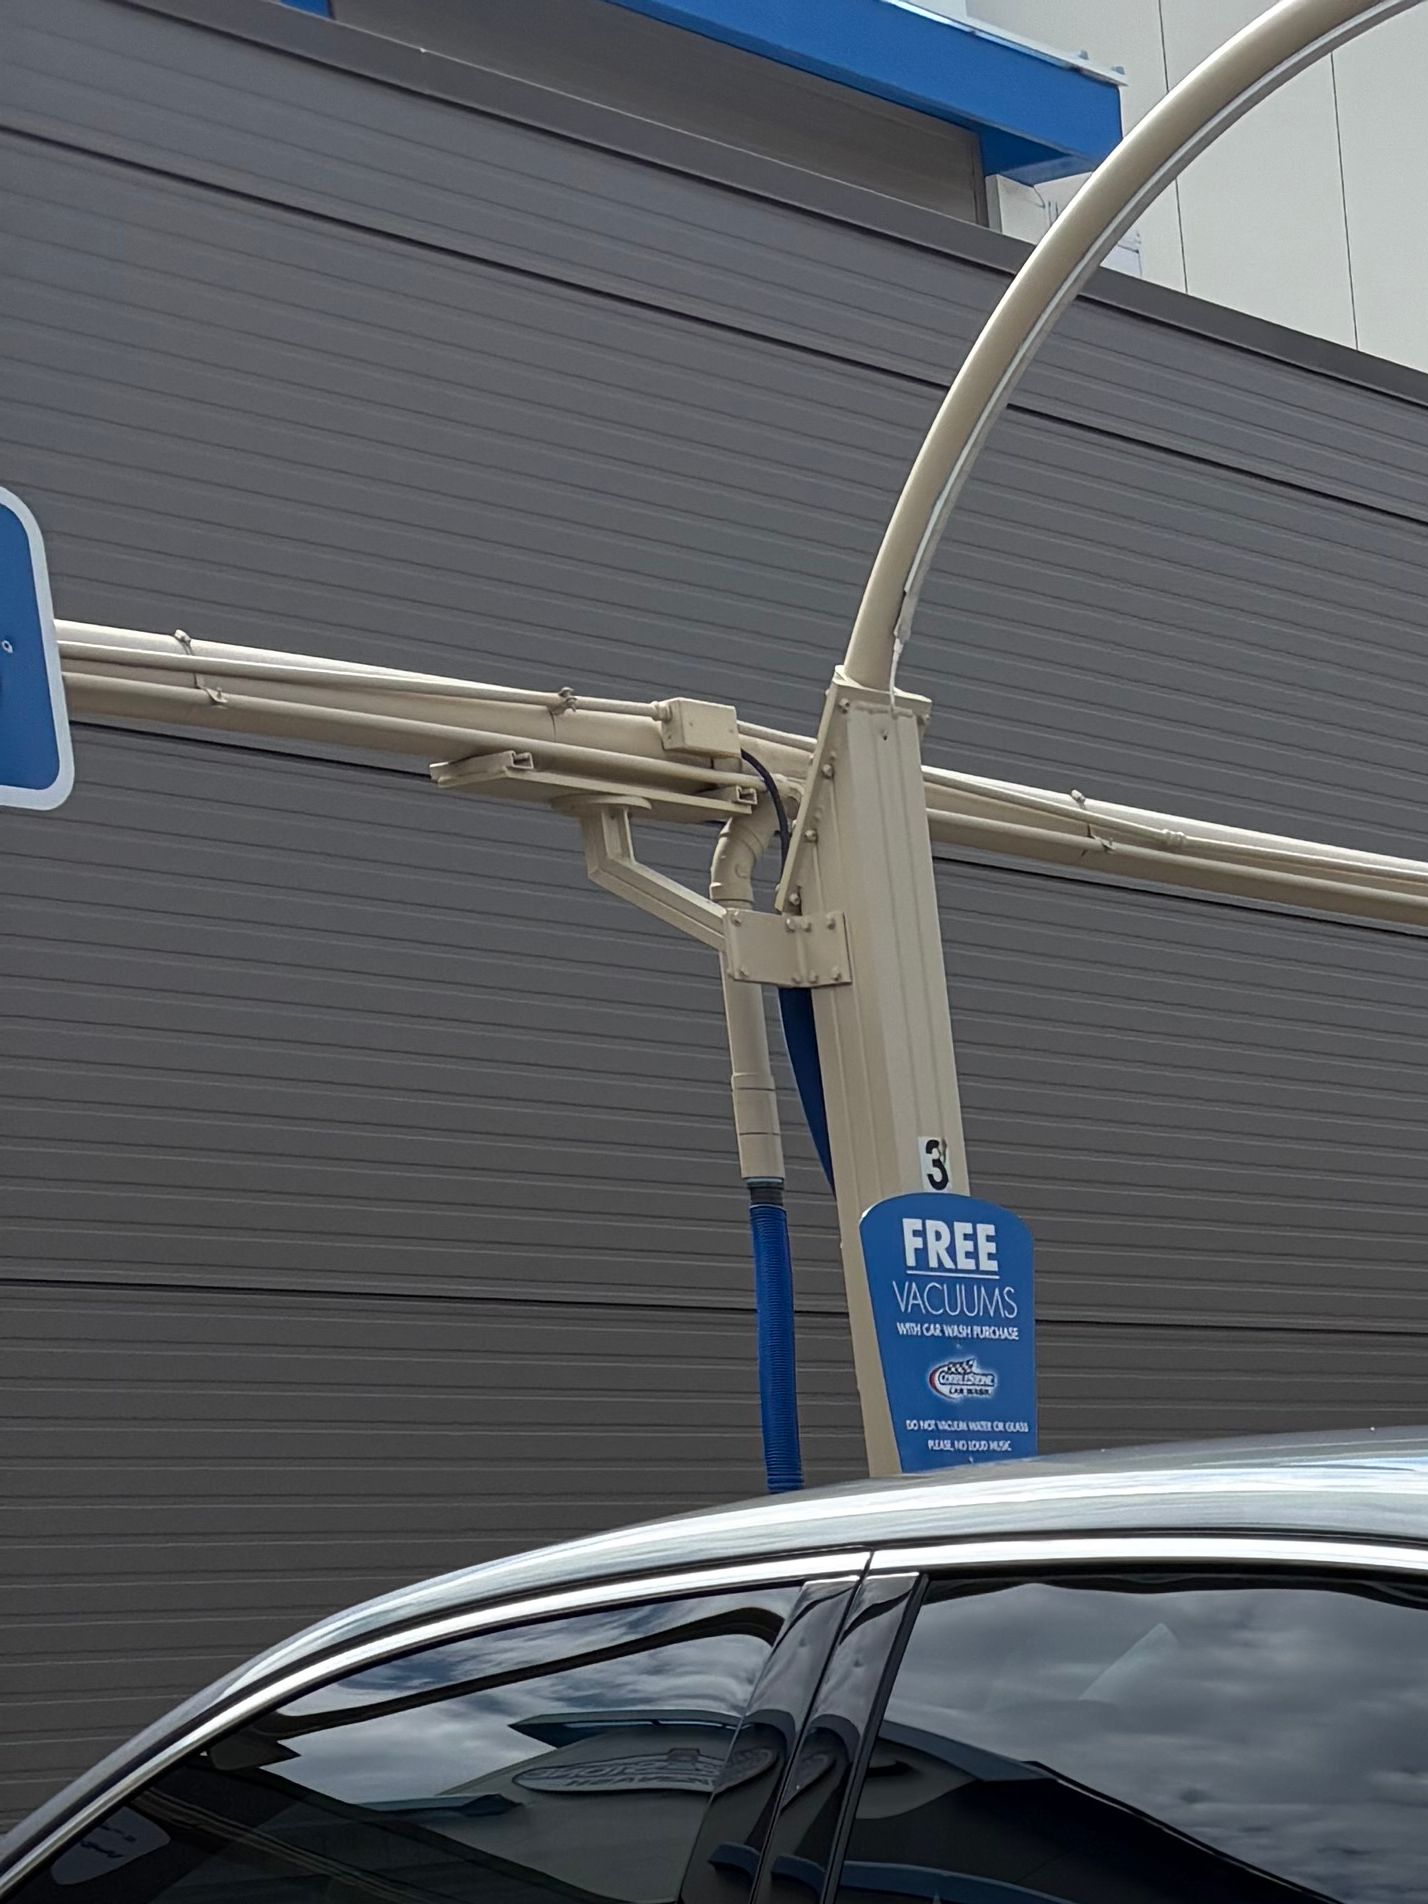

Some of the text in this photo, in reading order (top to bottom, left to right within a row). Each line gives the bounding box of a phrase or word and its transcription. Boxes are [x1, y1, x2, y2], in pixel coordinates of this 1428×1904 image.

[925, 1139, 949, 1191] 3
[902, 1218, 999, 1272] FREE
[892, 1280, 1018, 1319] VACUUMS
[896, 1322, 1019, 1340] WITH CAR WASH PURCHASE
[906, 1420, 918, 1430] DO
[920, 1420, 935, 1431] NOT
[955, 1440, 967, 1451] NO
